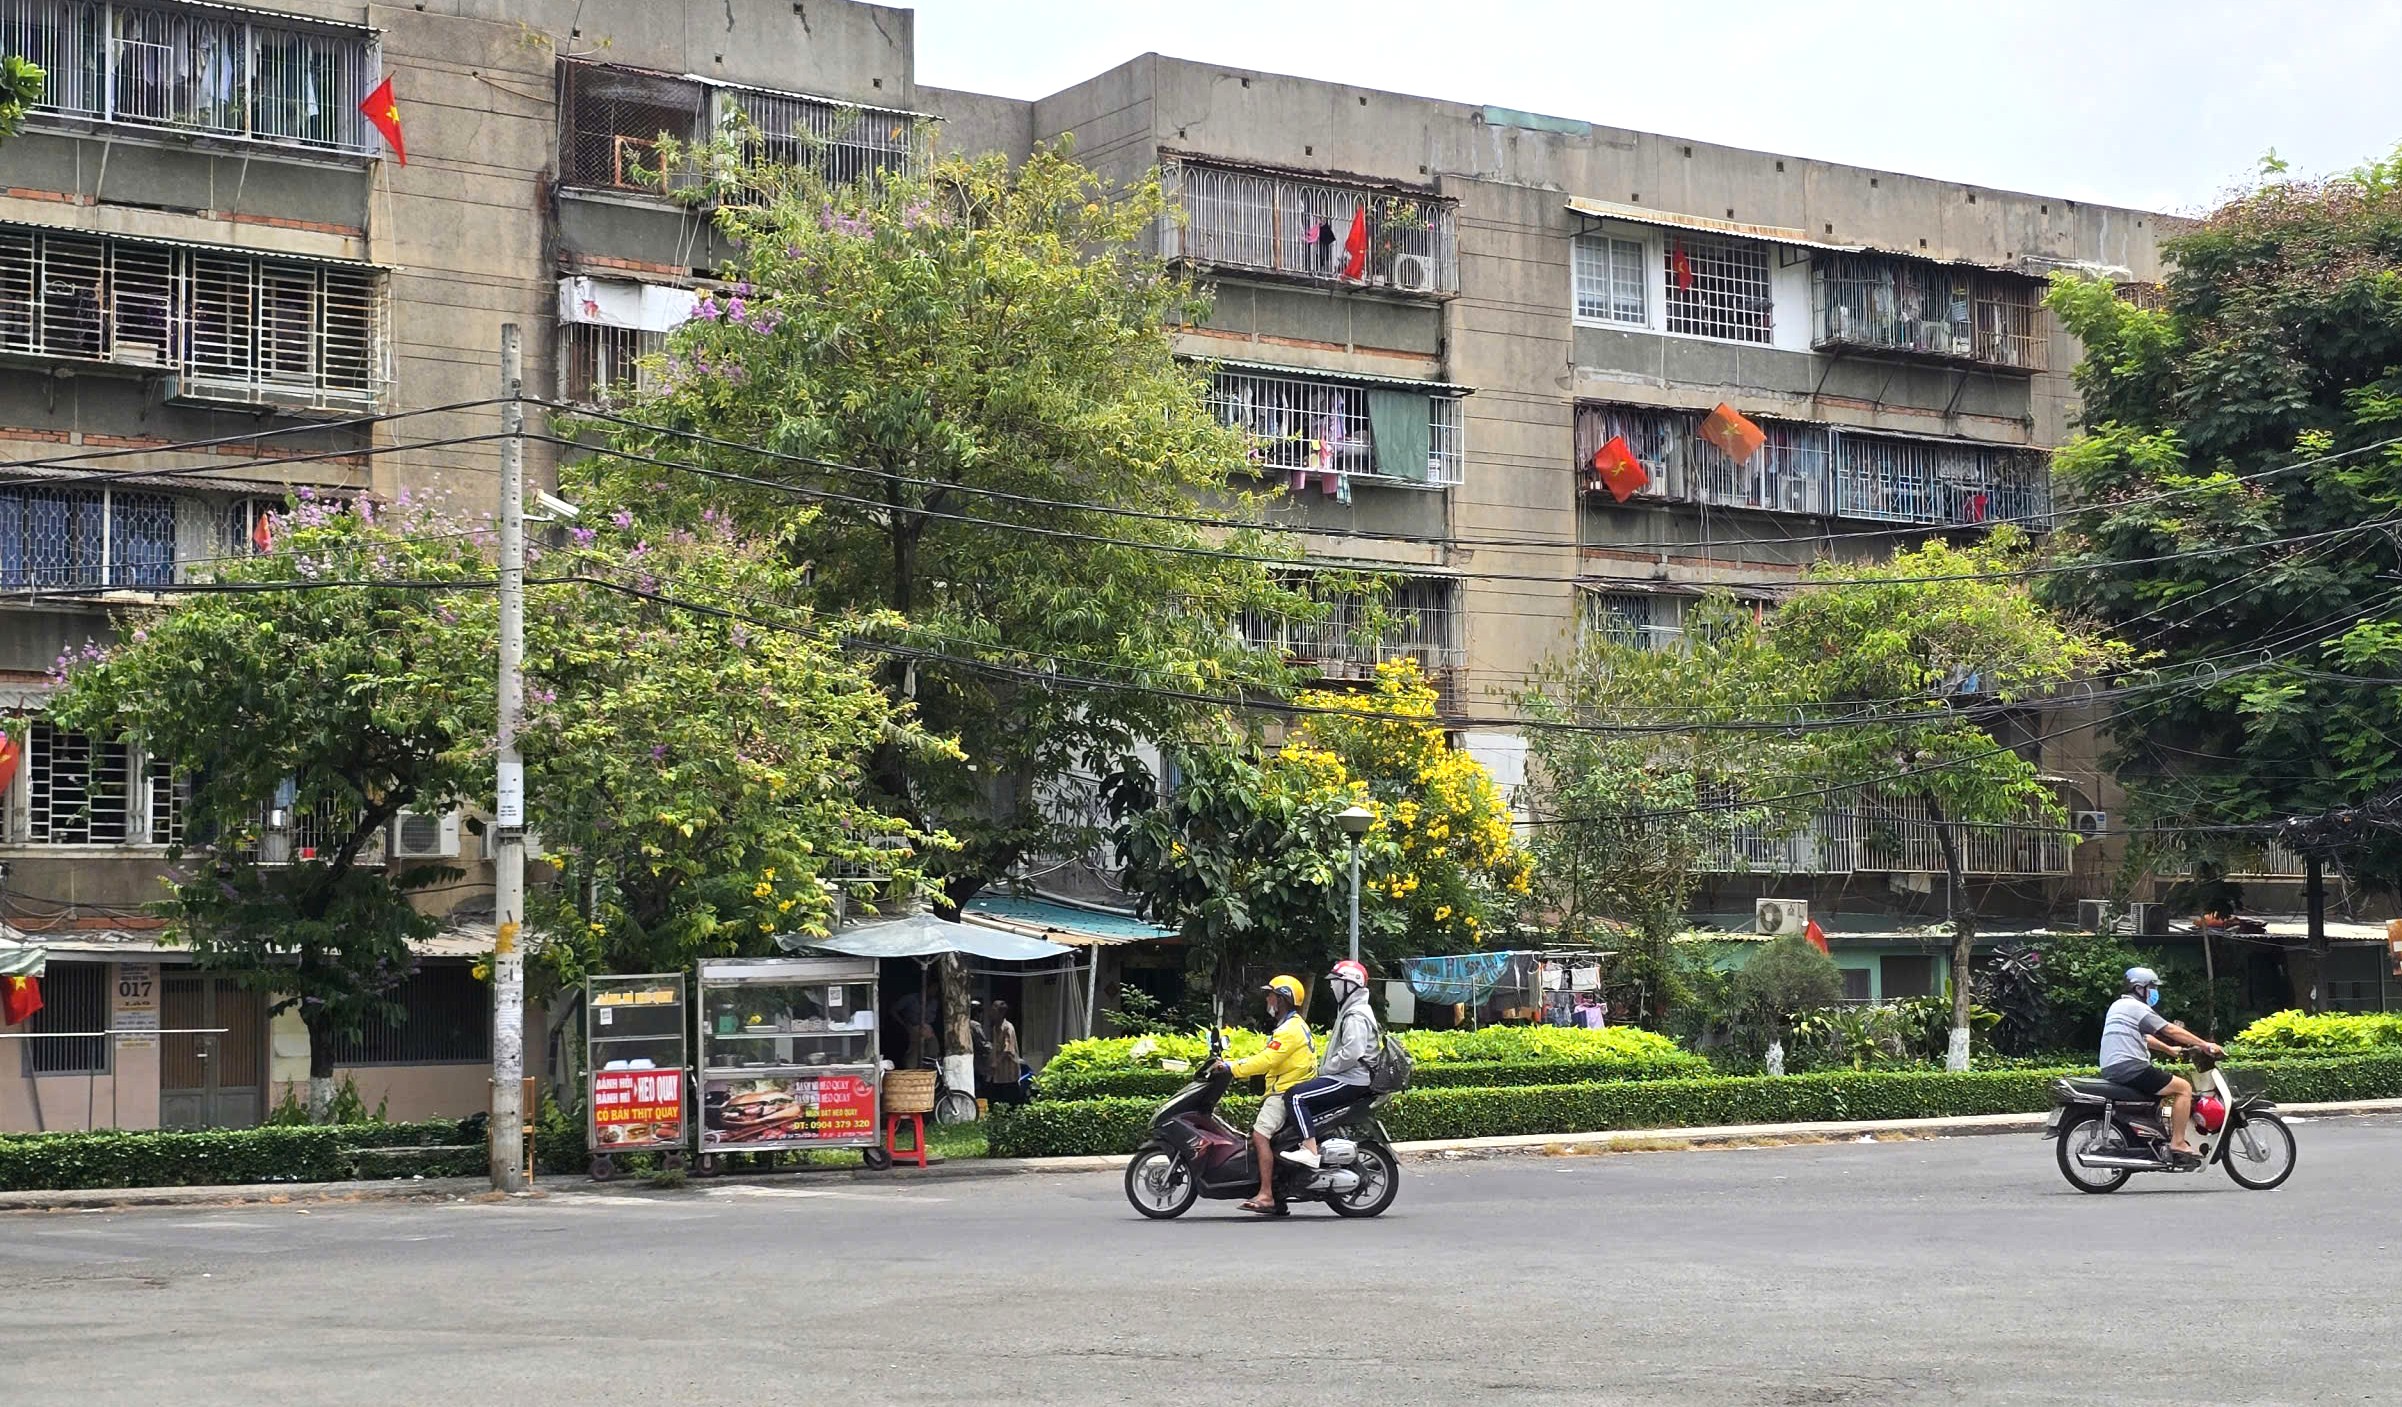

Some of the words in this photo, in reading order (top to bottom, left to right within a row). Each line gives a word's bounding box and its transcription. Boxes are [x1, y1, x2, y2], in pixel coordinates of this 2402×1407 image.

[119, 981, 153, 997] 017
[596, 1091, 618, 1104] BÁNH
[637, 1076, 655, 1102] HEO
[657, 1075, 678, 1104] QUAY
[596, 1107, 609, 1121] CÓ
[611, 1106, 629, 1121] BÁN
[632, 1107, 653, 1122] THỊT
[656, 1106, 678, 1120] QUAY
[810, 1120, 832, 1129] 0904
[835, 1120, 851, 1128] 379
[854, 1119, 870, 1127] 320
